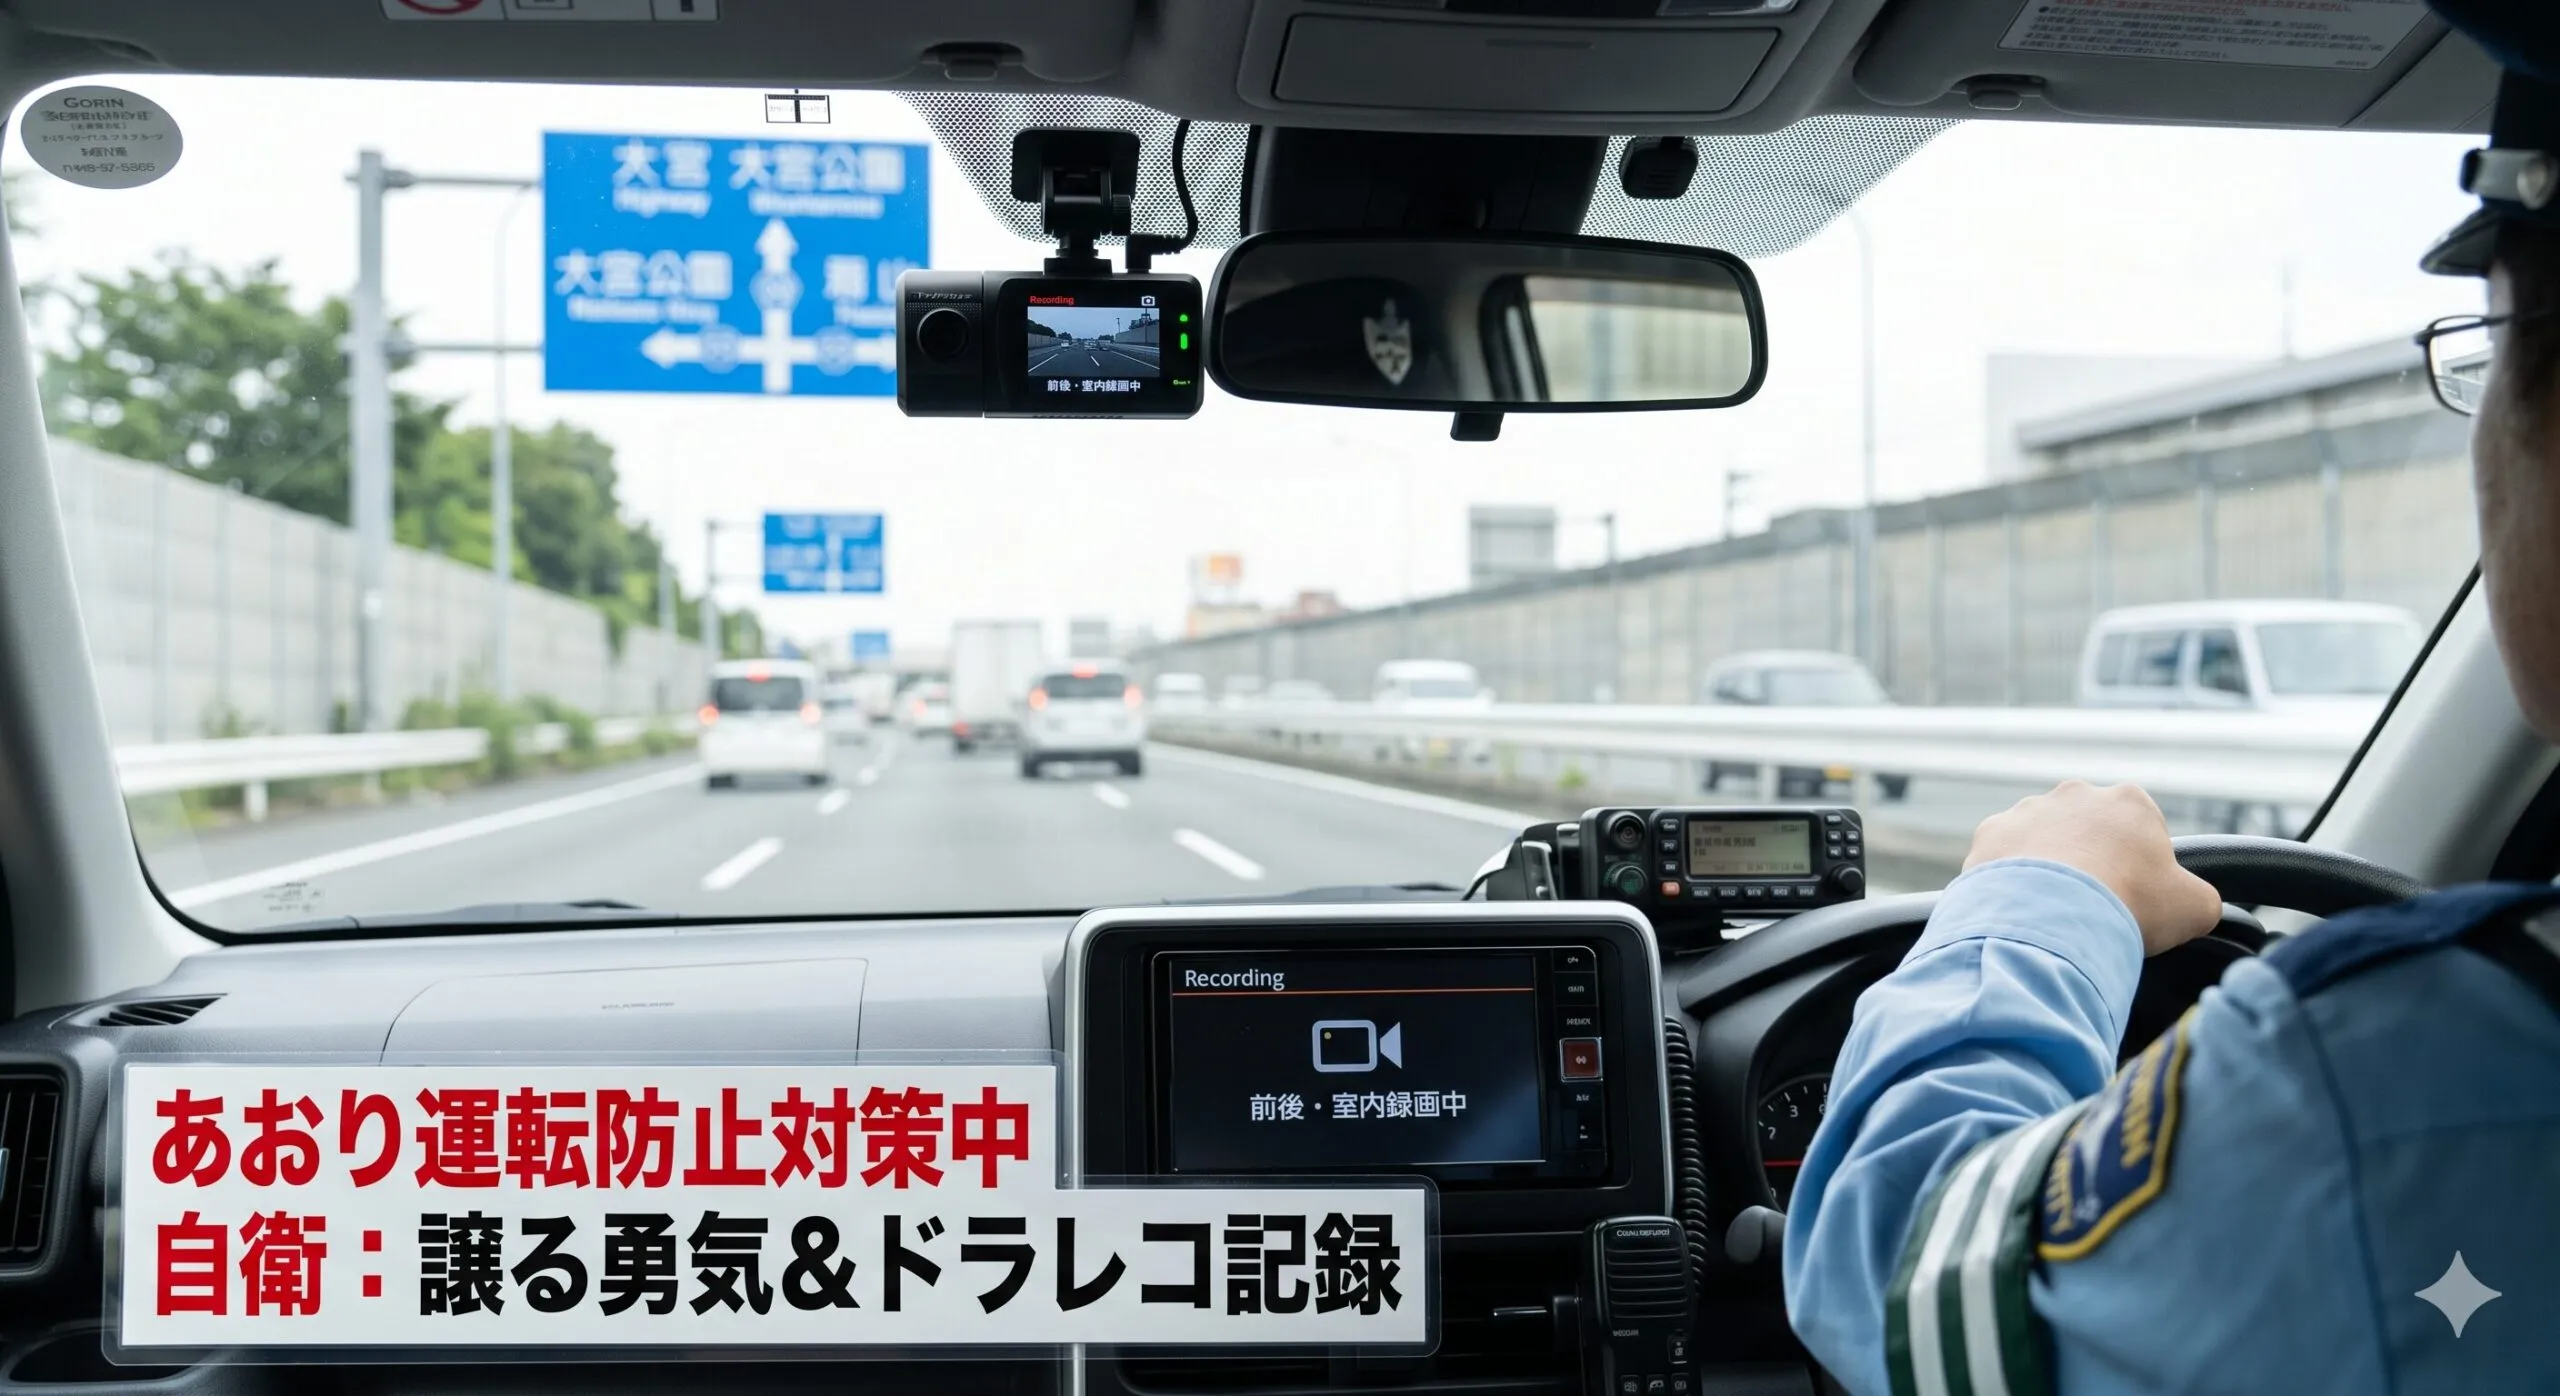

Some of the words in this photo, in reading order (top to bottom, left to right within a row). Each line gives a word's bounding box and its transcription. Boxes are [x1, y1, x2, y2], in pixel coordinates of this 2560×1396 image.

[63, 97, 125, 109] GORIN
[1029, 295, 1075, 307] Recording
[1184, 968, 1286, 992] Recording
[1249, 1090, 1468, 1122] 前後・室内録画中
[152, 1086, 1030, 1189] あおり運転防止対策中
